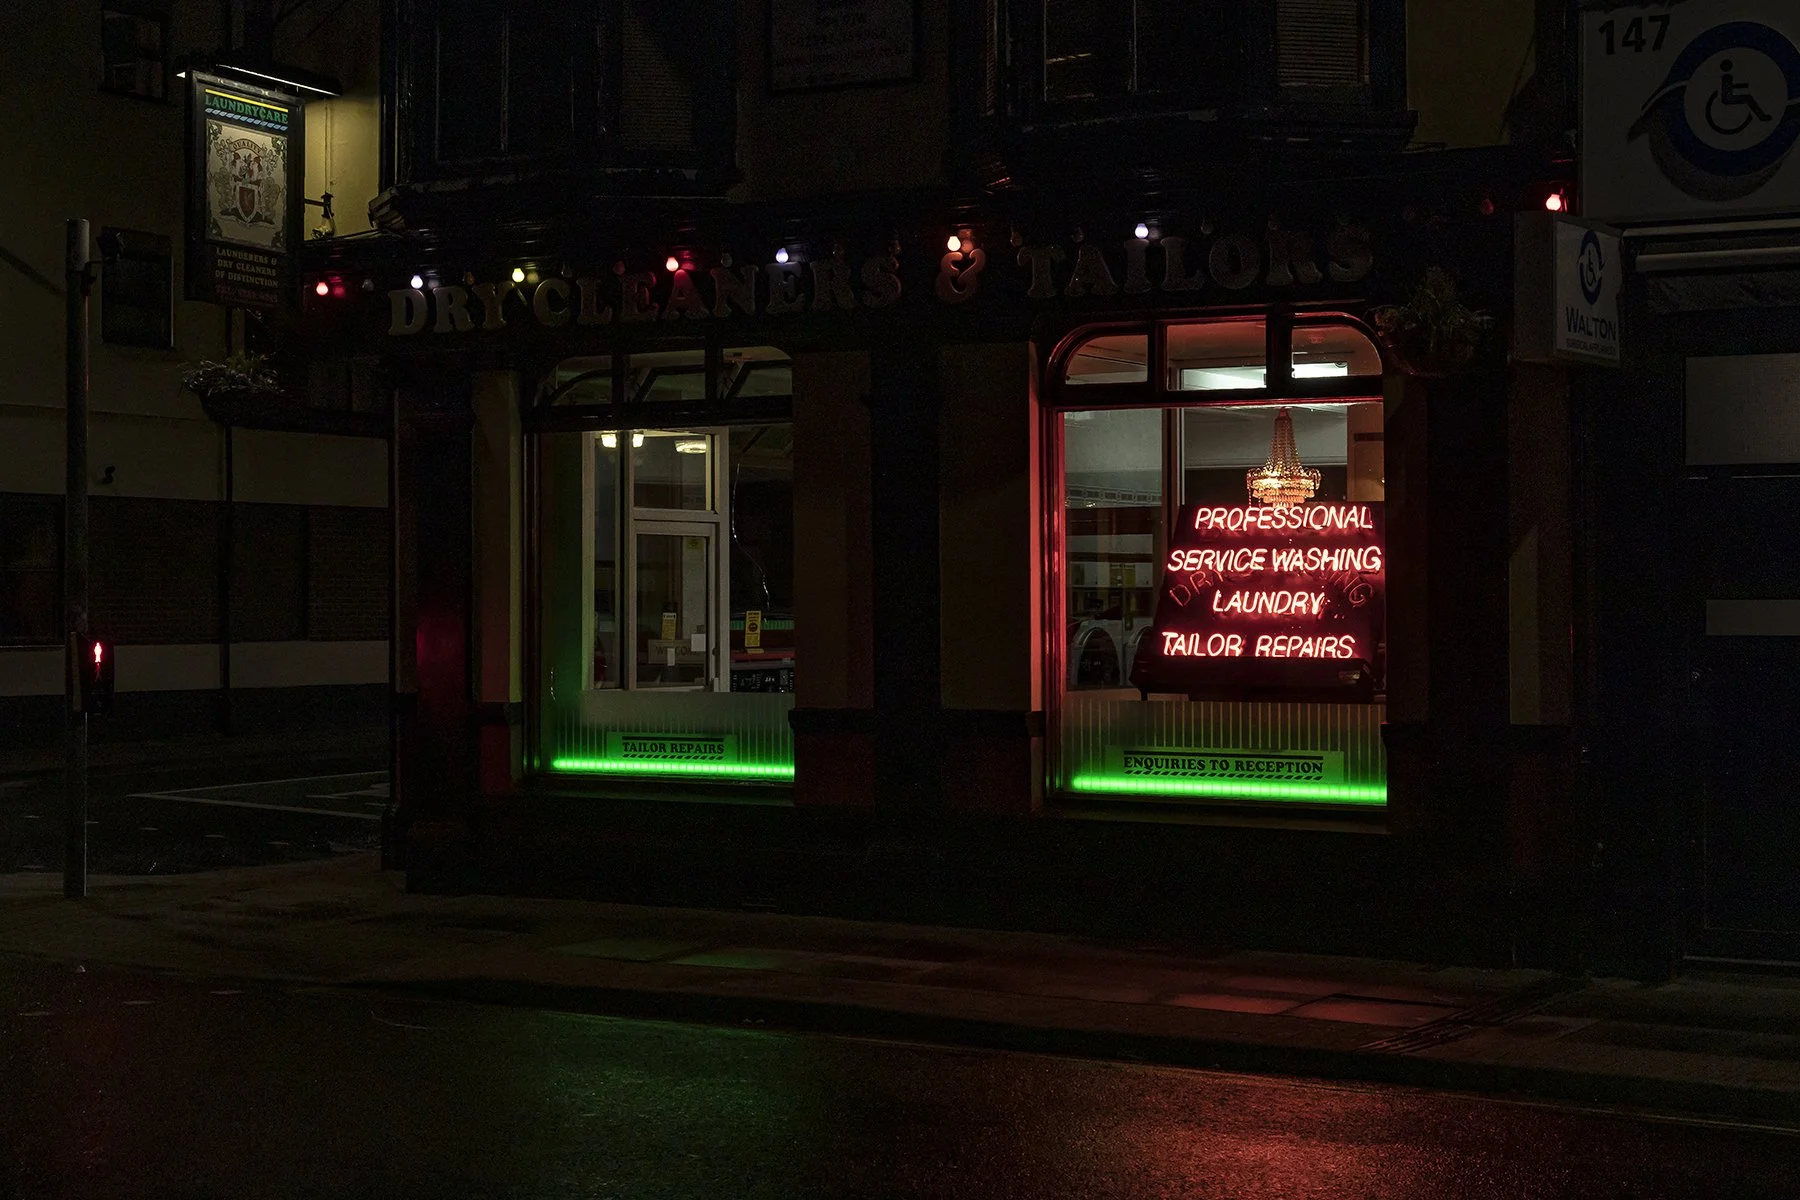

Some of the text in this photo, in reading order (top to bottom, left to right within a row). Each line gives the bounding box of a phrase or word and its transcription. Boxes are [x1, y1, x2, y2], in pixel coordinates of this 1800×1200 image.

[1599, 15, 1670, 55] 147
[204, 94, 288, 124] LAUNDRYCARE
[233, 140, 261, 153] QUALITY
[215, 269, 280, 289] OF DISTINCTION
[217, 258, 277, 277] DRY CLEANERS
[388, 227, 1374, 336] DRY CLEANERS & TAILORS
[1566, 306, 1617, 341] WALTON
[1194, 505, 1374, 532] PROFESSIONAL
[1167, 545, 1383, 573] SERVICE WASHING
[1212, 589, 1325, 615] LAUNDRY
[1161, 631, 1356, 659] TAILOR REPAIRS
[622, 741, 724, 755] TAILOR REPAIRS
[1124, 756, 1324, 774] ENQUIRIES TO RECEPTION
